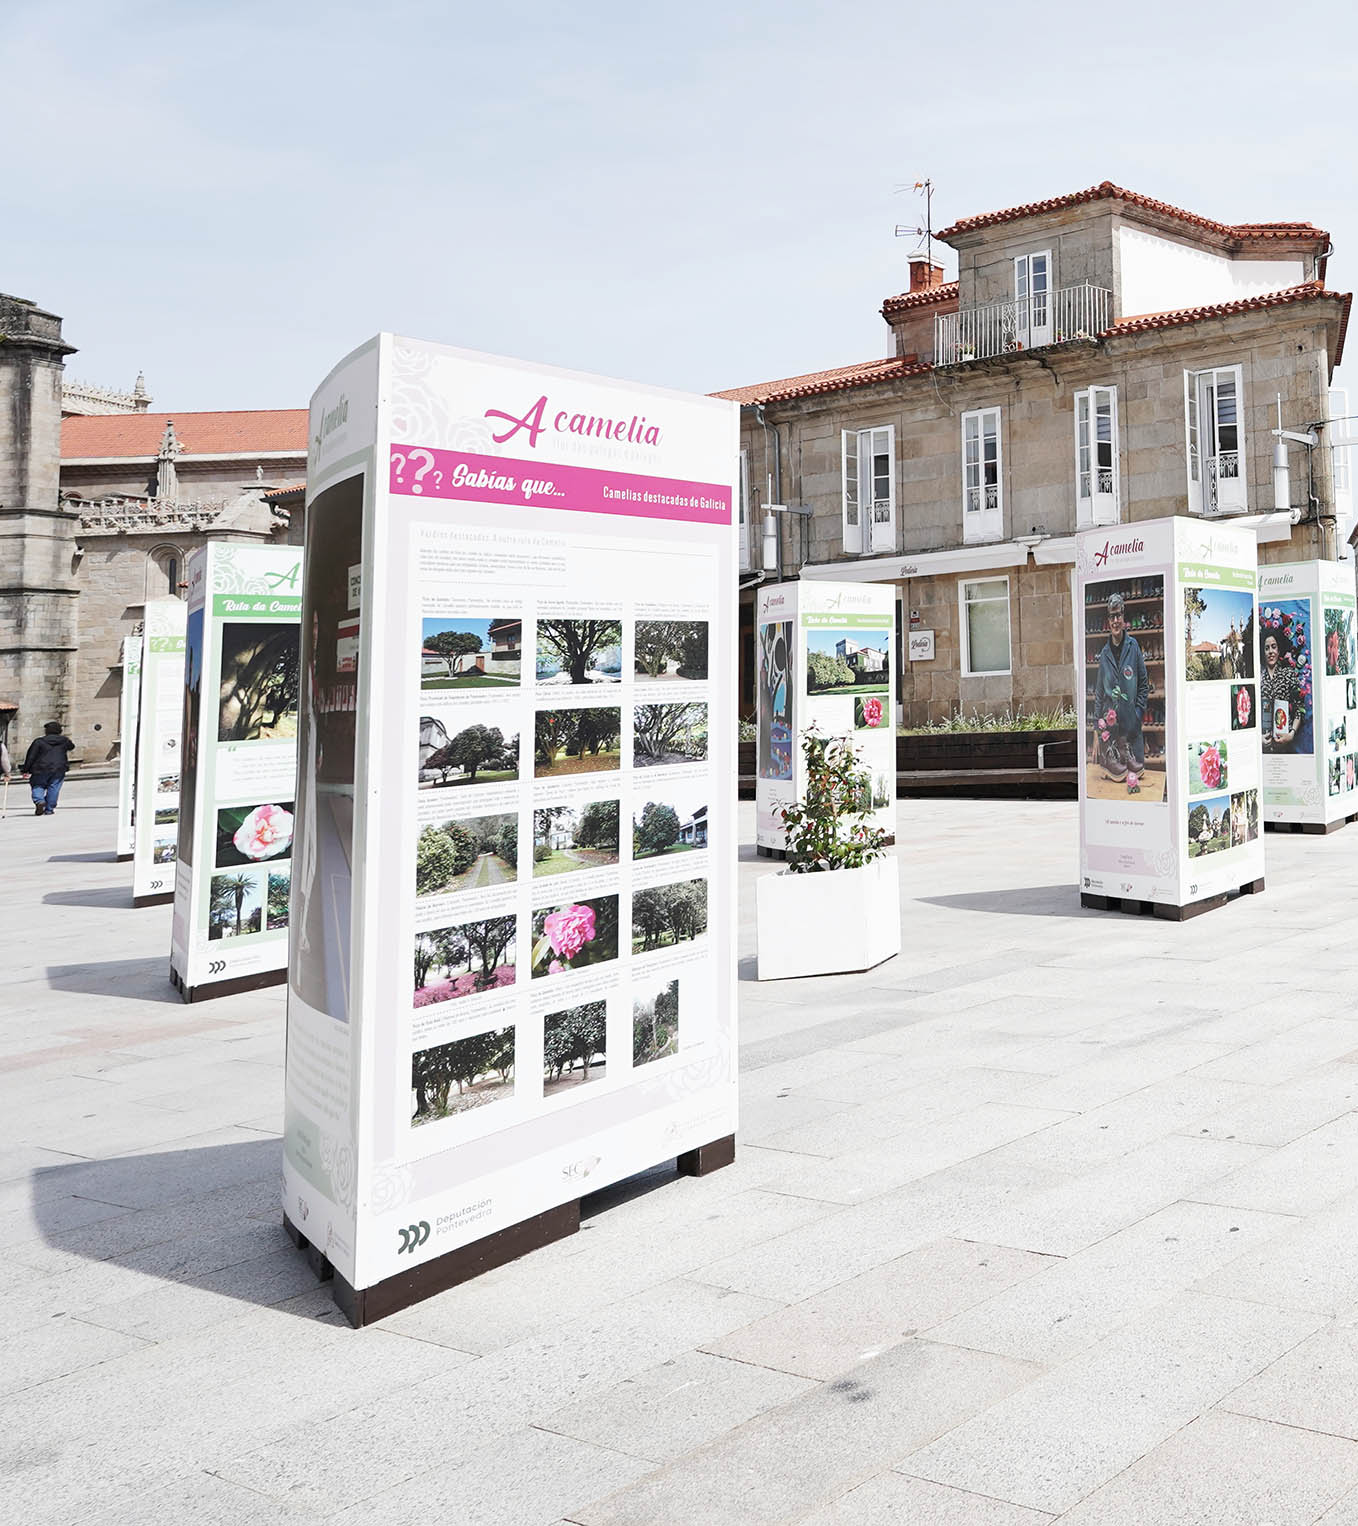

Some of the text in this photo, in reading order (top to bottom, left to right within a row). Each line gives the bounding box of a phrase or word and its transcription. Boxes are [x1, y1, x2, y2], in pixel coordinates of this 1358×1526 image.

[484, 395, 663, 448] A camelia
[451, 463, 566, 500] Sabías que...
[603, 485, 726, 511] Camelias destacadas de Galicia
[1095, 537, 1144, 567] A camelia
[264, 562, 301, 590] A
[1263, 573, 1294, 586] camelia
[222, 599, 302, 613] Ruta da Camel
[436, 1208, 492, 1236] Pontevedra
